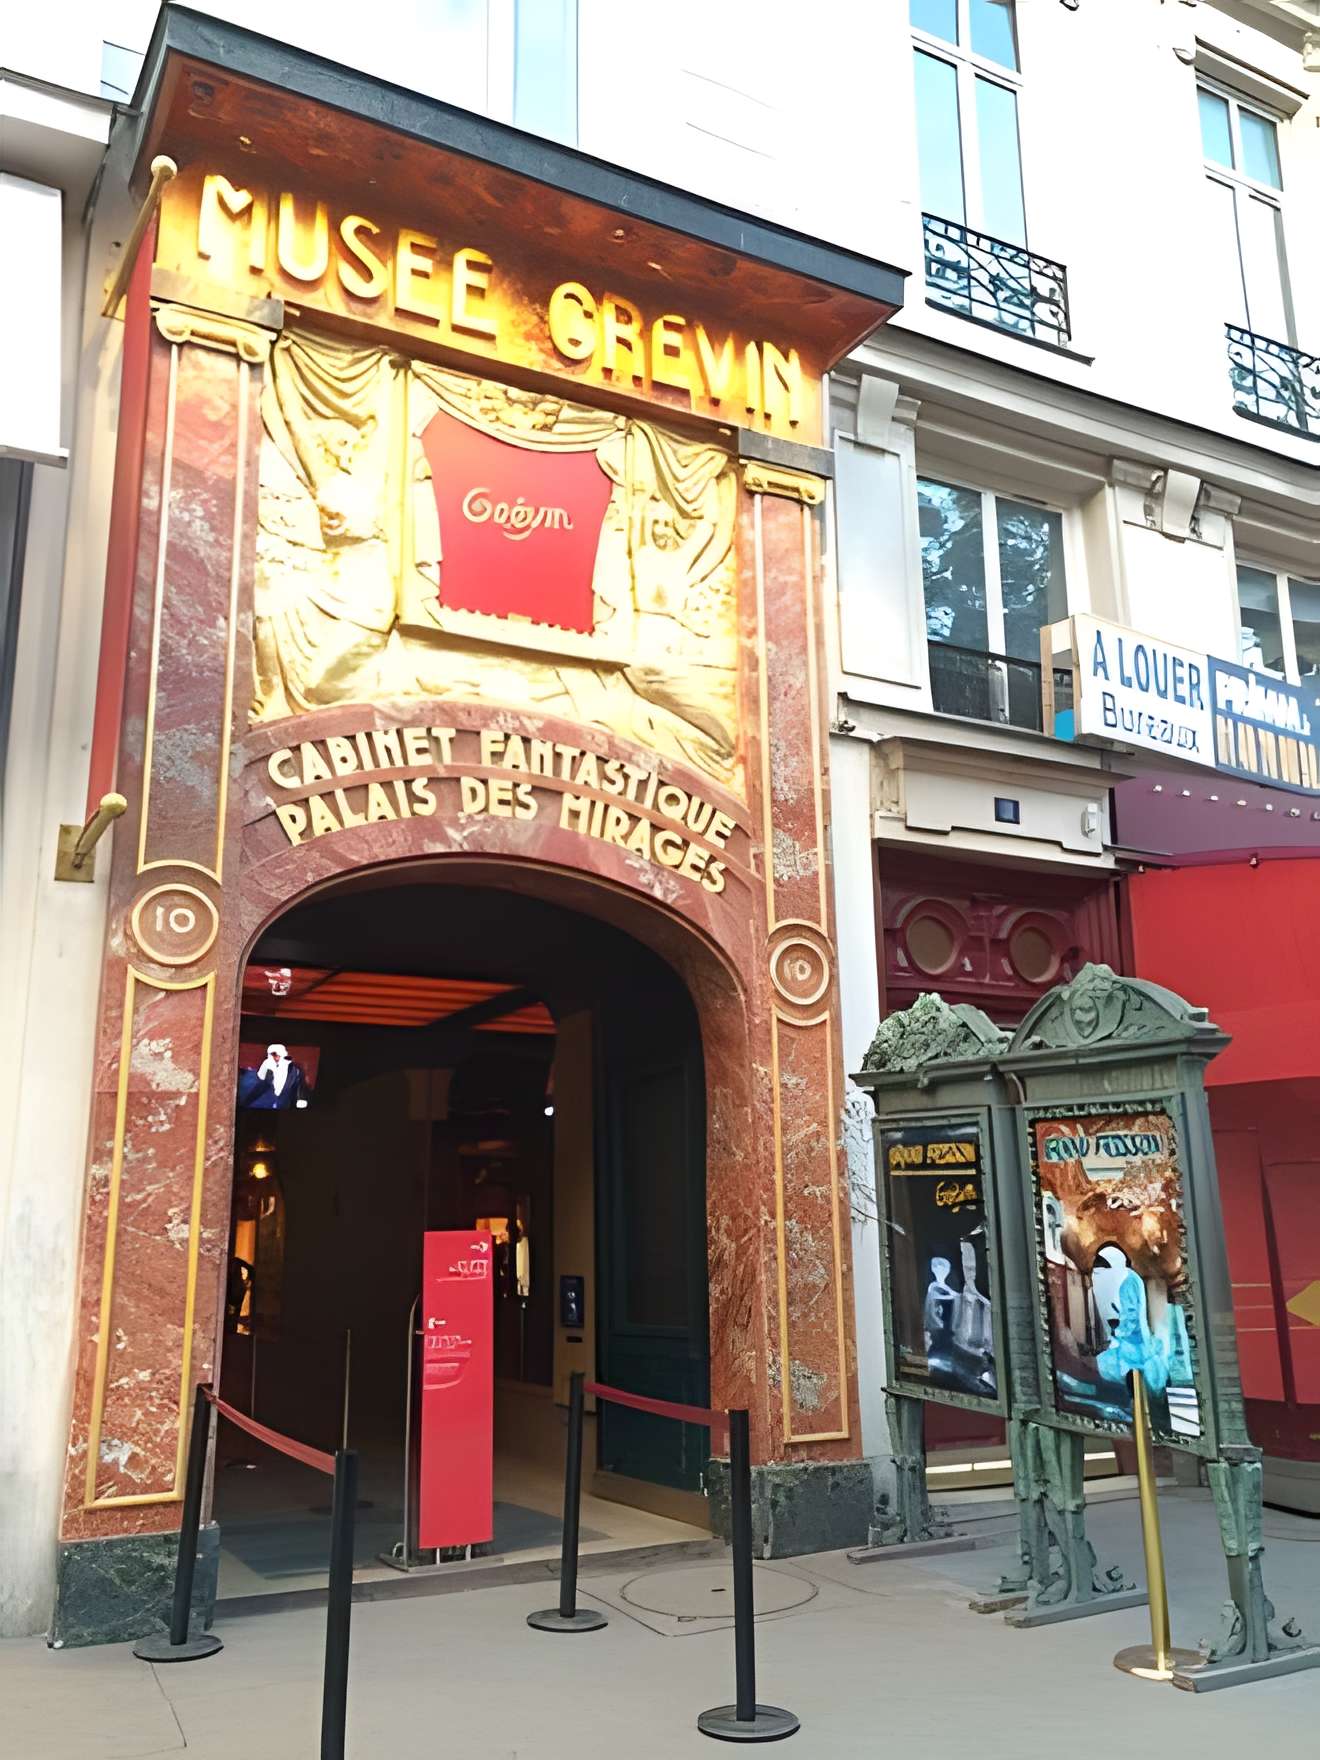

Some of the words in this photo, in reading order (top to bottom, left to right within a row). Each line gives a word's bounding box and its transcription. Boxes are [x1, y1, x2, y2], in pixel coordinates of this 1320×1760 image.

[196, 174, 497, 341] MUSEE
[548, 281, 803, 427] GREVIN
[1093, 629, 1110, 681] A
[1117, 637, 1204, 711] LOUER
[267, 727, 456, 790] CABINET
[480, 729, 738, 850] FANTASTIQUE
[275, 777, 437, 847] PALAIS
[460, 777, 538, 820] DES
[559, 795, 728, 895] MIRAGES
[156, 906, 196, 933] 10
